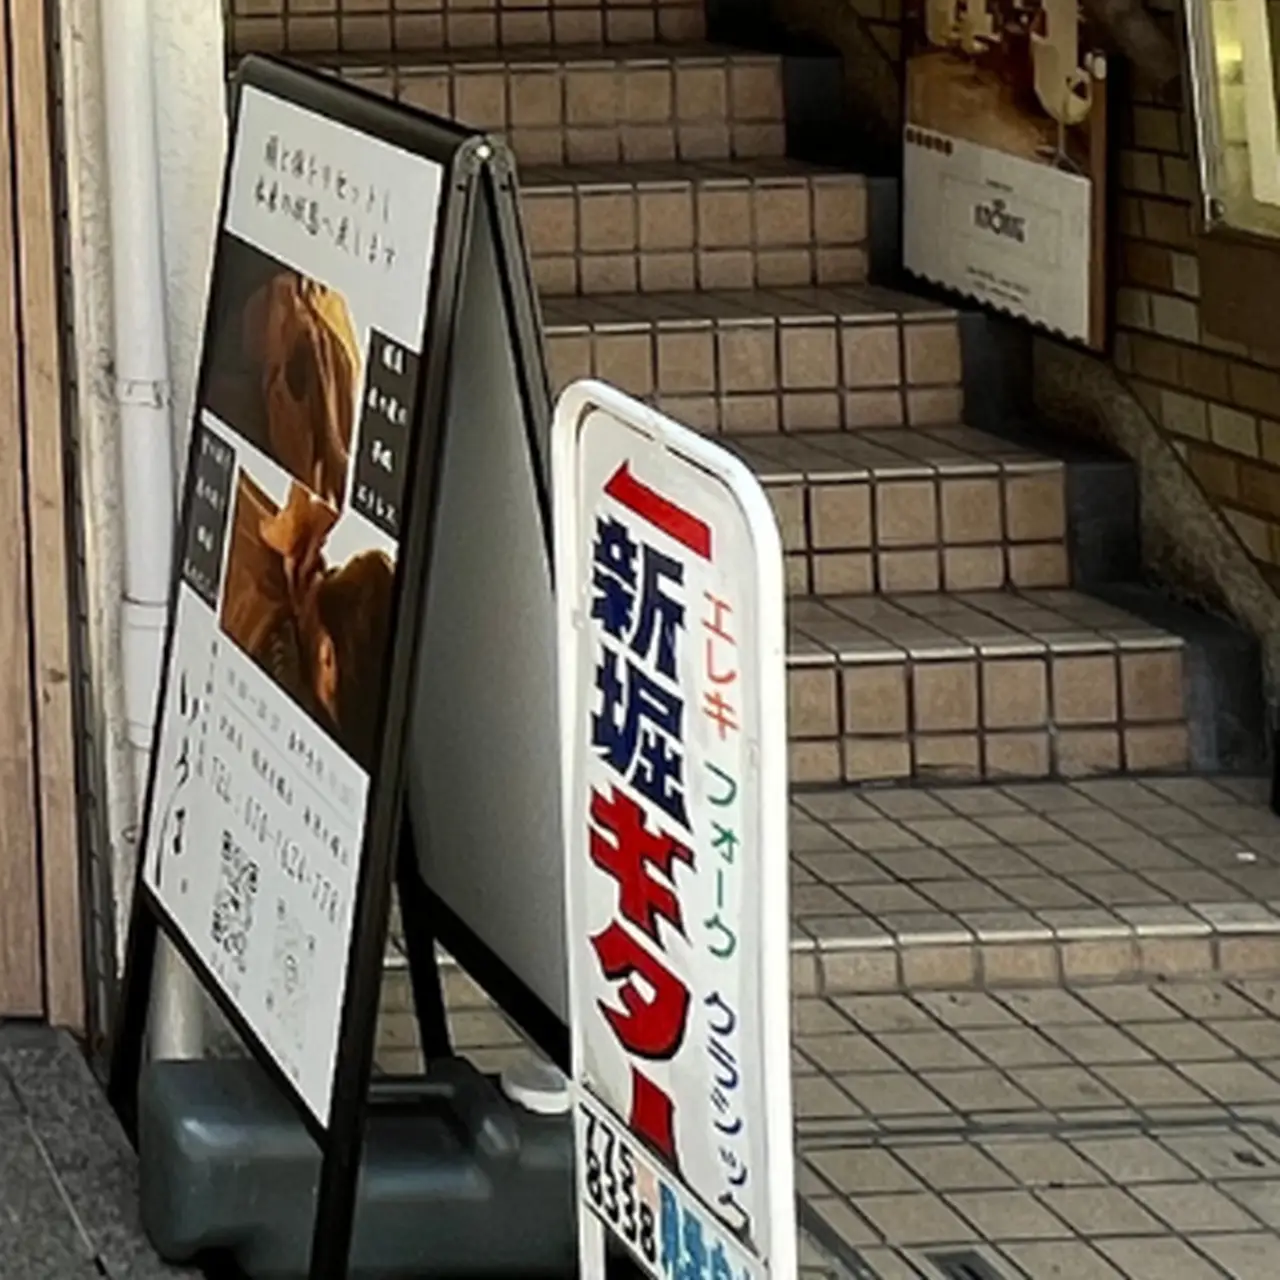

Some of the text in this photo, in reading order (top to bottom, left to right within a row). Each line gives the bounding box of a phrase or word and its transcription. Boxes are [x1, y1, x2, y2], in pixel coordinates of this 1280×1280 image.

[701, 588, 741, 741] エレキ
[587, 514, 698, 1176] 新堀ギター
[702, 760, 740, 960] フォーク
